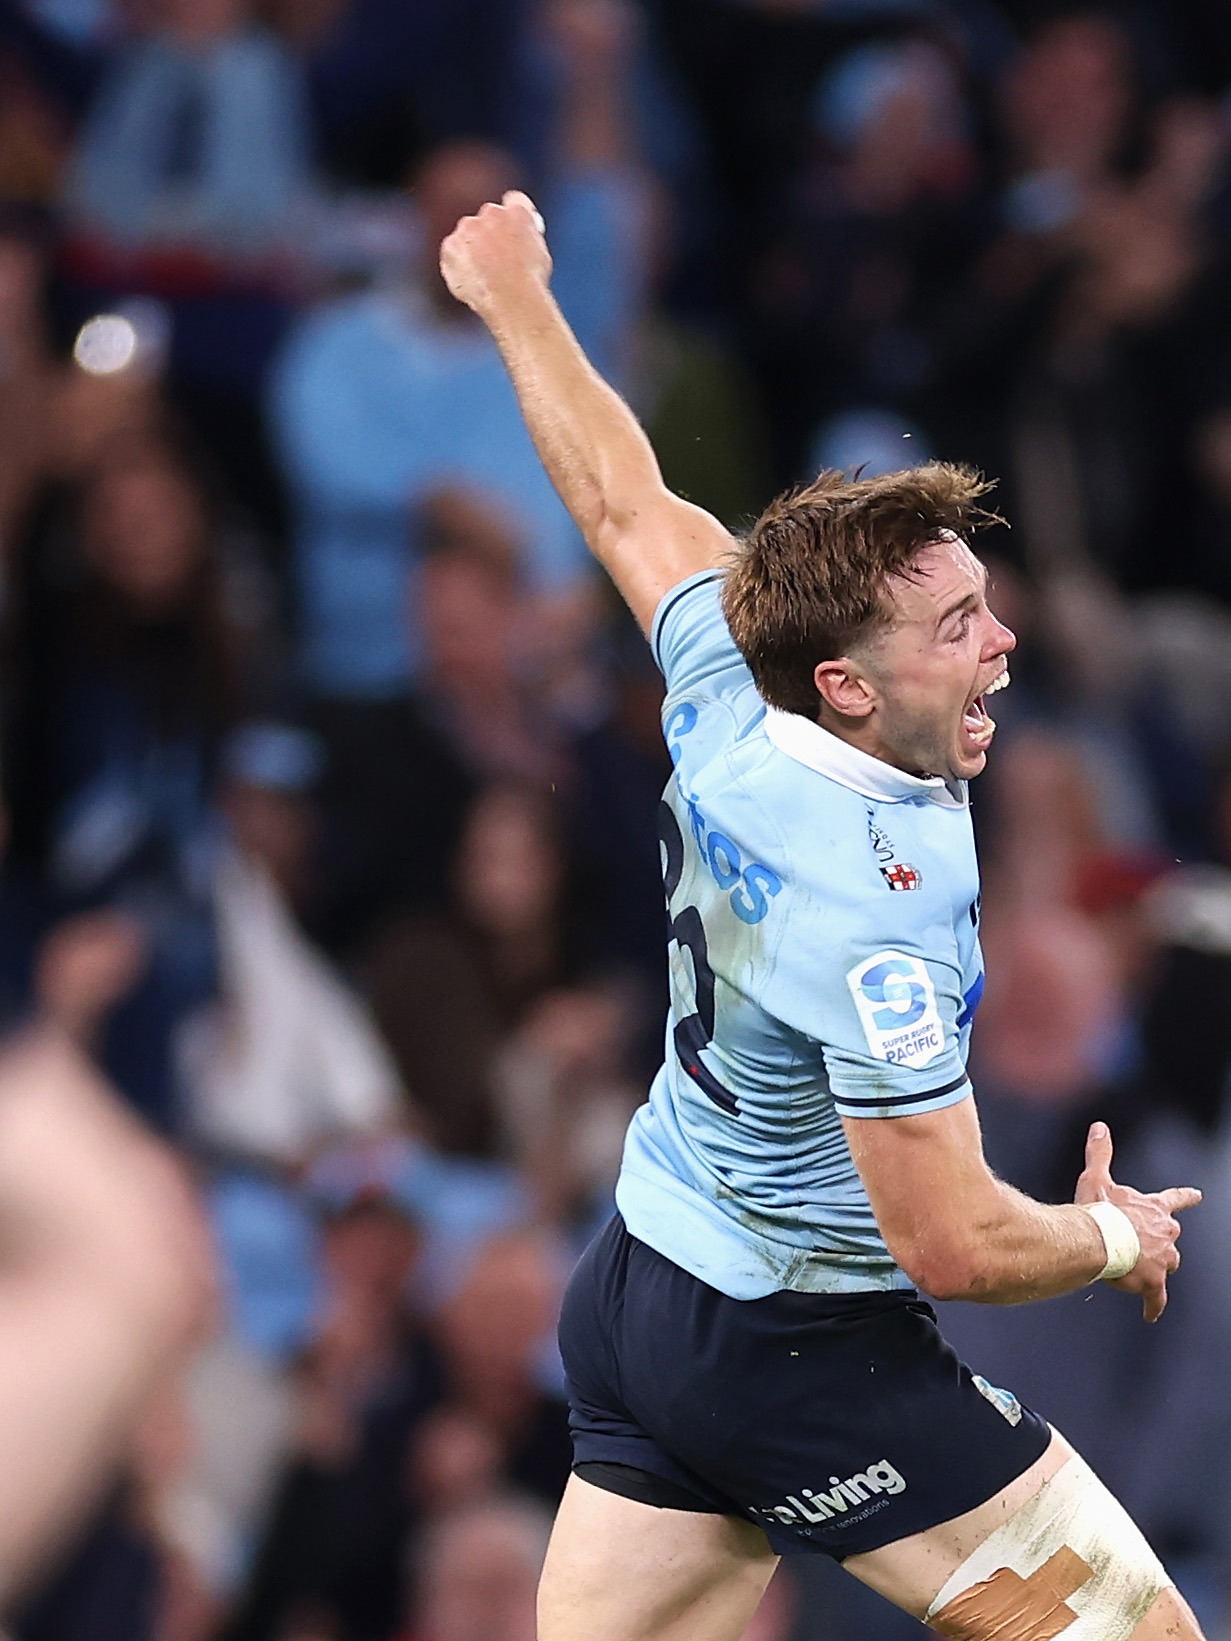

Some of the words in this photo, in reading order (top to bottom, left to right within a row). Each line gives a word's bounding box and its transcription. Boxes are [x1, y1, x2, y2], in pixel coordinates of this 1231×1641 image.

[881, 1034, 910, 1049] SUPER
[911, 1022, 935, 1038] RUGBY
[885, 1033, 939, 1062] PACIFIC
